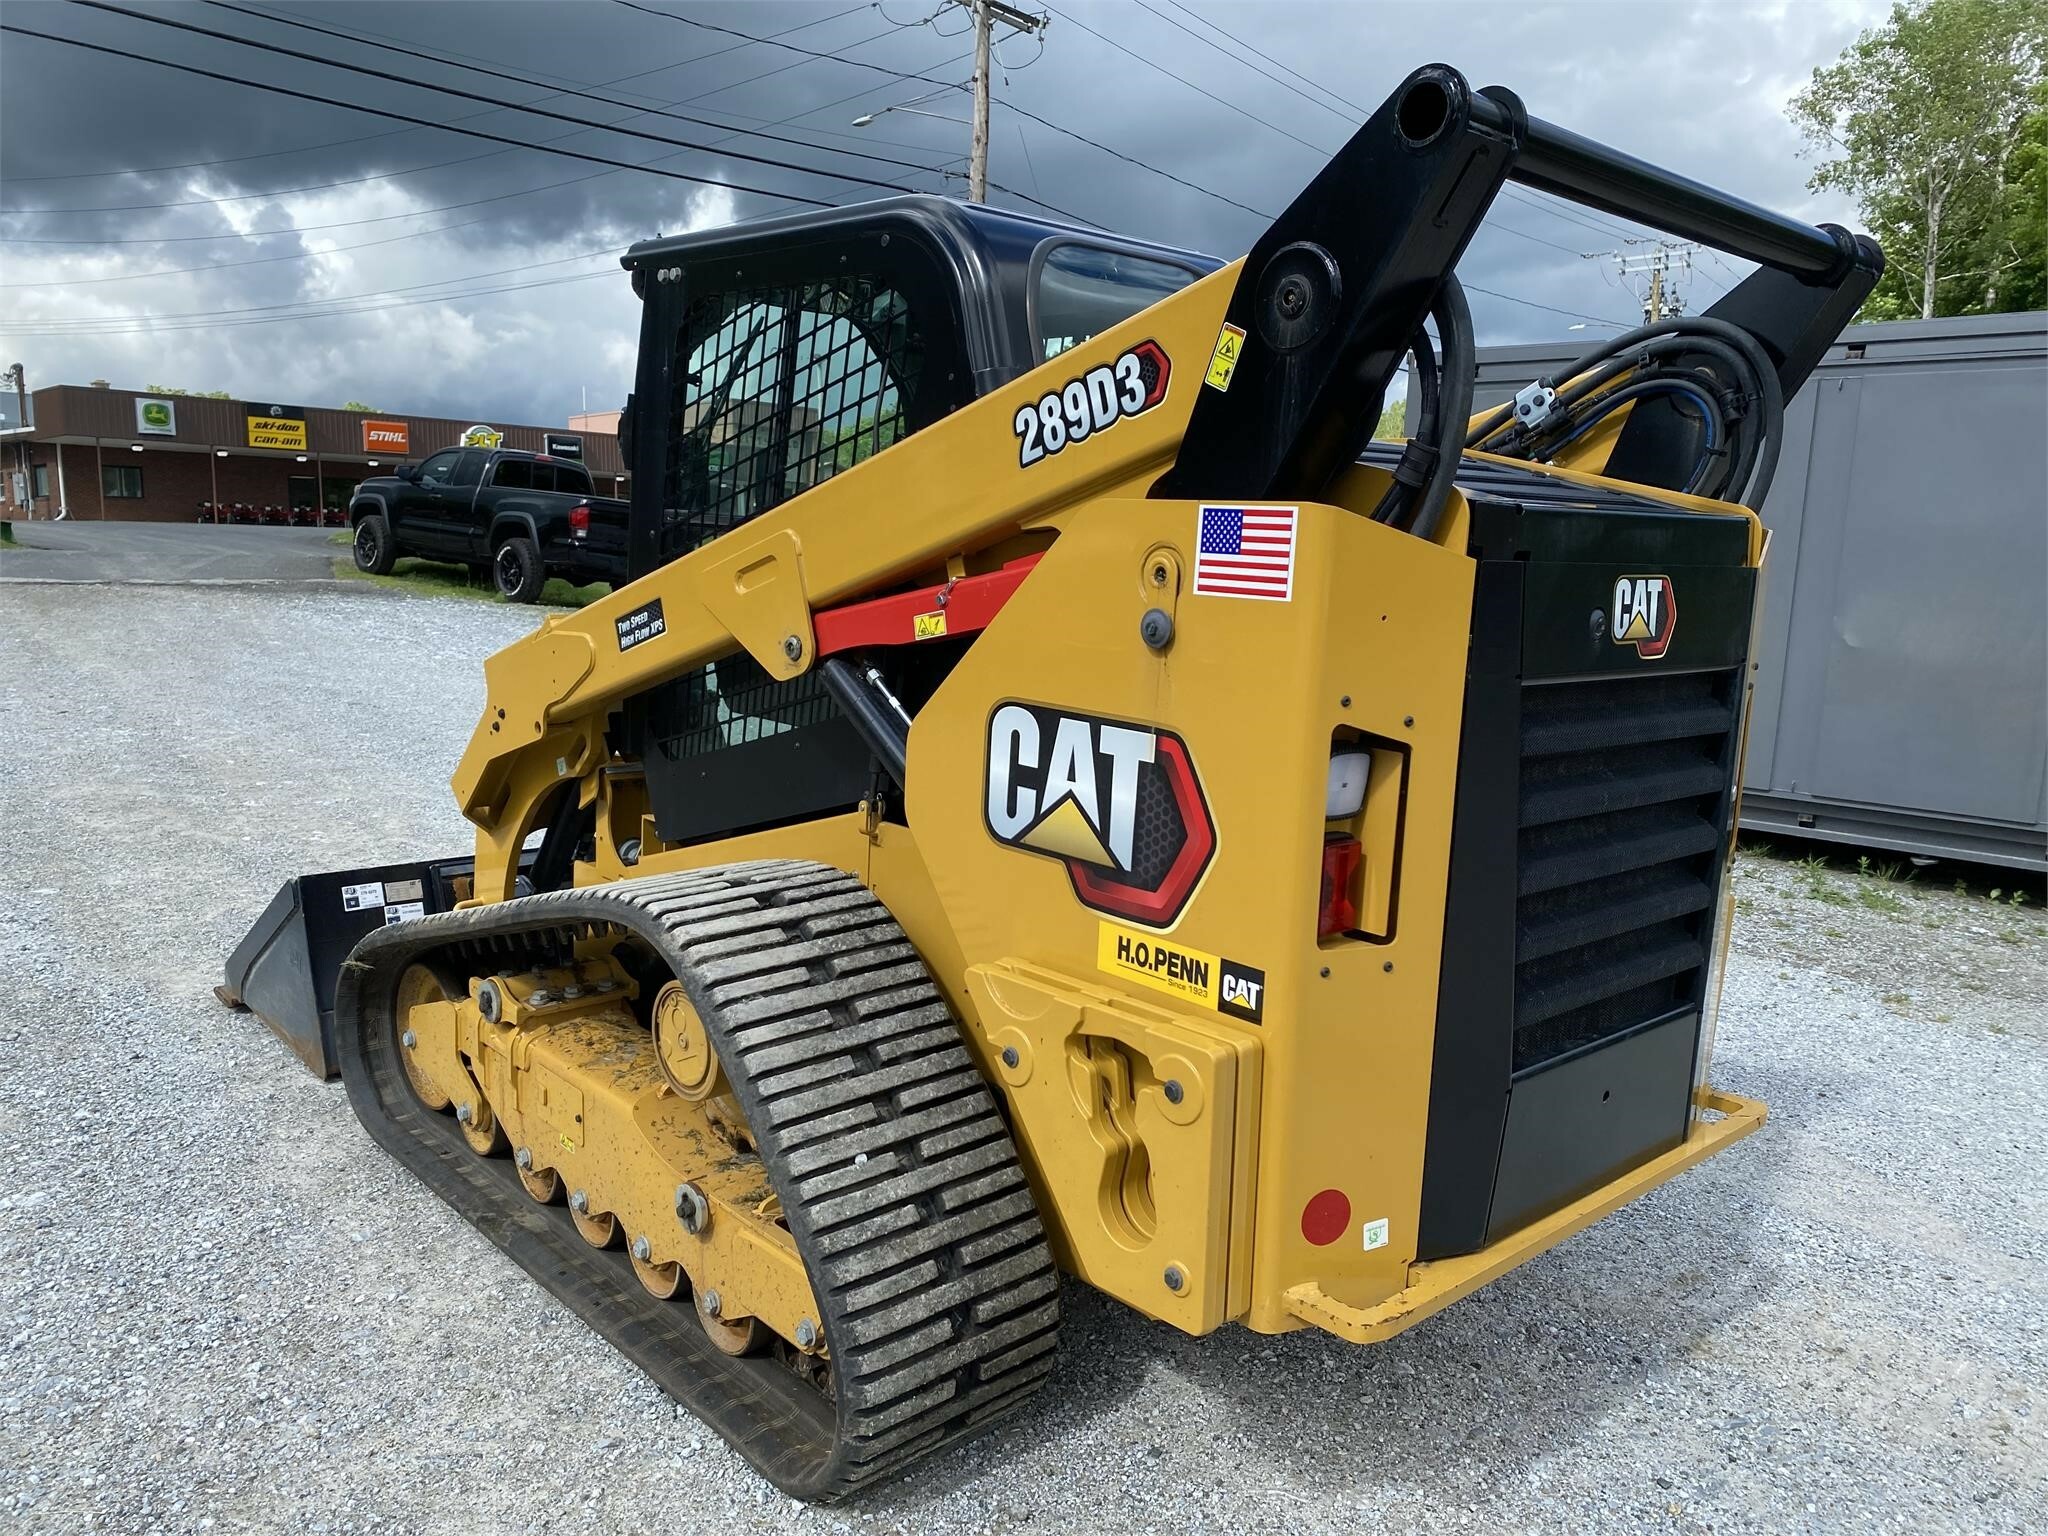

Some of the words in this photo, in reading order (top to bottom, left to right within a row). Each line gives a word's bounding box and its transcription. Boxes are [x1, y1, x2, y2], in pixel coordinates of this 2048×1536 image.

[1015, 353, 1146, 465] 289D3
[254, 420, 300, 432] ski-doo
[369, 430, 406, 442] STIHL
[254, 435, 302, 446] can-am
[1614, 578, 1663, 640] CAT
[650, 618, 663, 635] XPS
[988, 705, 1156, 873] CAT
[1167, 978, 1187, 991] Since
[1189, 985, 1208, 998] 1923
[1222, 974, 1260, 1011] CAT
